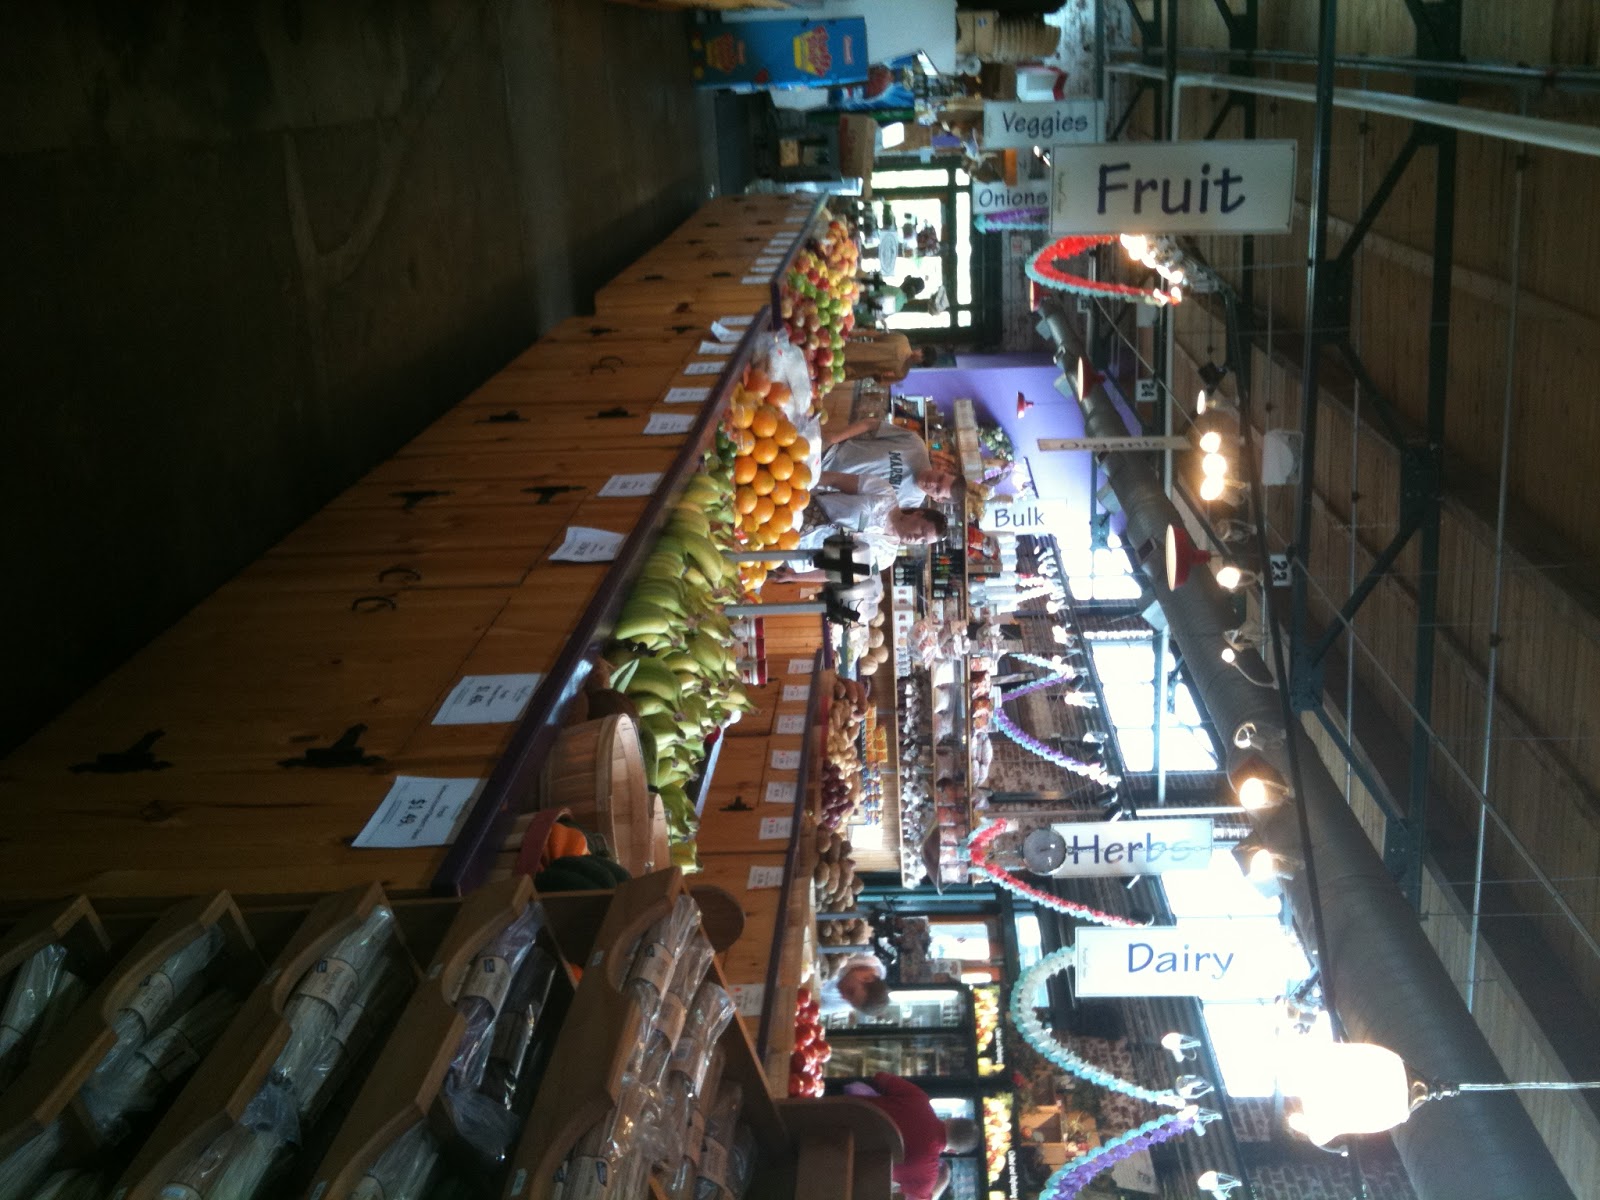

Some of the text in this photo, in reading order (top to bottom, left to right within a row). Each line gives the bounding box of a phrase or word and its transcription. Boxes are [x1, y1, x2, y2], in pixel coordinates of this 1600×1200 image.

[1002, 111, 1088, 140] Veggies
[978, 188, 1048, 207] Onions
[1096, 163, 1246, 215] Fruit
[888, 451, 902, 496] MARSHA
[994, 507, 1045, 528] Bulk
[1072, 832, 1191, 865] Herbs
[1127, 943, 1234, 980] Dairy
